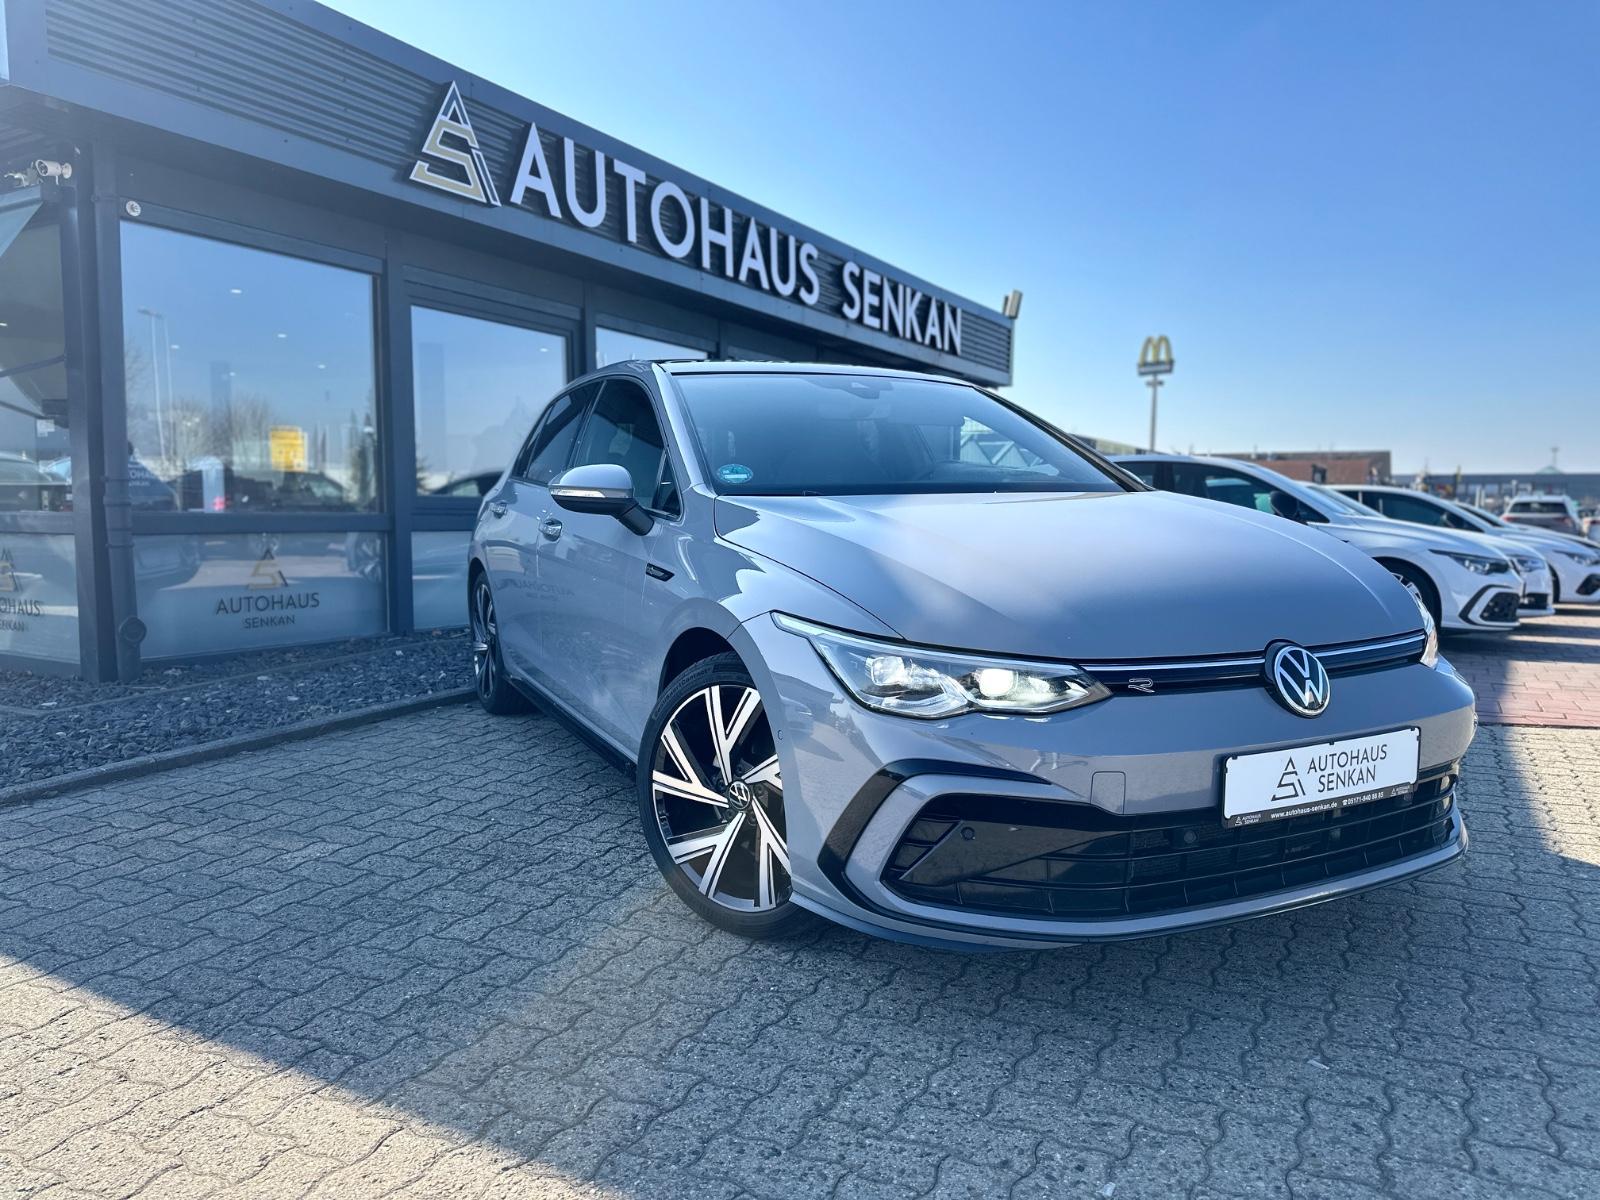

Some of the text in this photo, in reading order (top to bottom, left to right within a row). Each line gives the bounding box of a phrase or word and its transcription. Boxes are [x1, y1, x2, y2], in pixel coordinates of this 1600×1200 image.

[509, 121, 963, 355] AUTOHAUS SENKAN
[215, 592, 320, 615] AUTOHAUS
[243, 615, 296, 629] SENKAN
[1307, 744, 1388, 774] AUTOHAUS
[1317, 764, 1377, 793] SENKAN
[1270, 801, 1338, 819] www.autohaus-senkan.de
